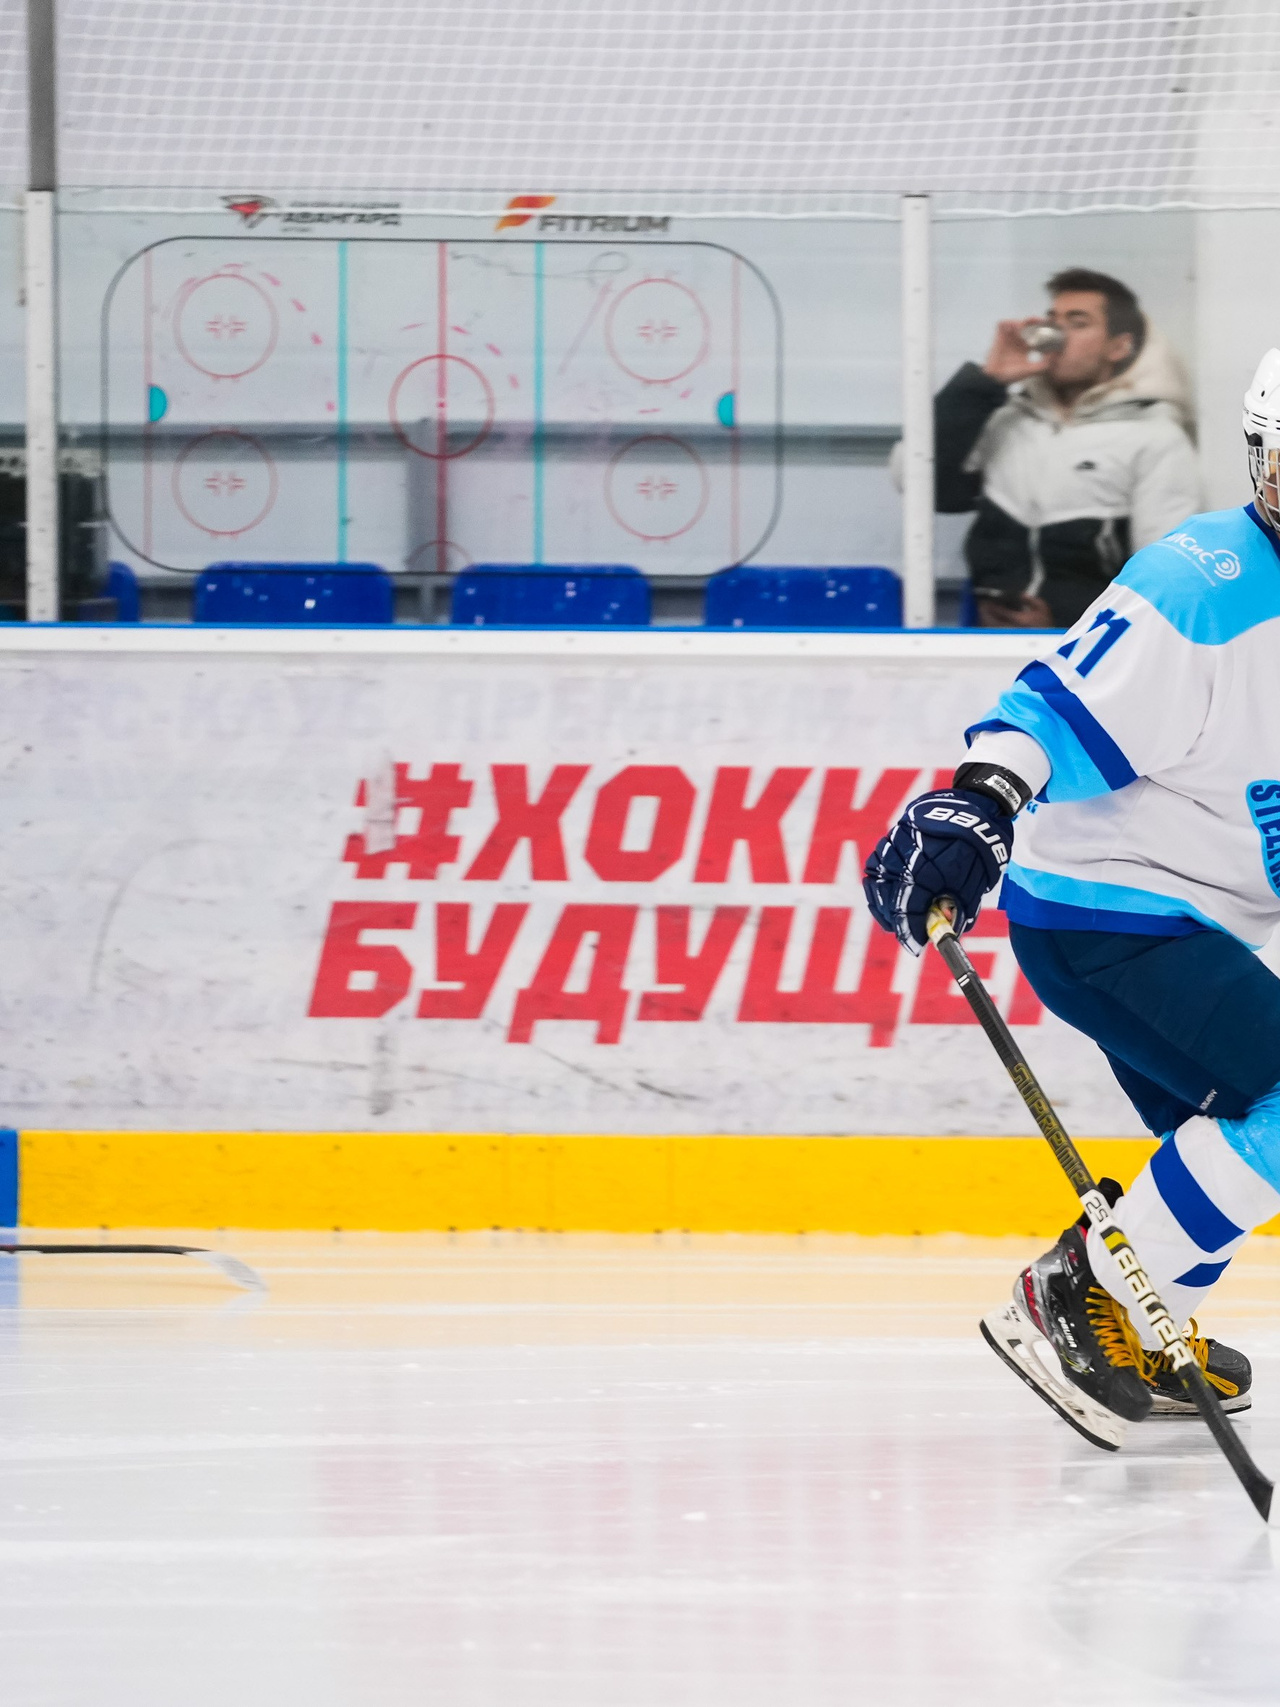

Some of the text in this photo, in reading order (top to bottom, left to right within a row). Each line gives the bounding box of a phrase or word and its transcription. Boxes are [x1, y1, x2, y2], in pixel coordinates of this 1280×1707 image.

[539, 215, 671, 233] FITRIUM
[343, 761, 955, 882] #ХОКК
[923, 806, 1009, 873] BAUE
[1111, 1246, 1195, 1374] BAUER
